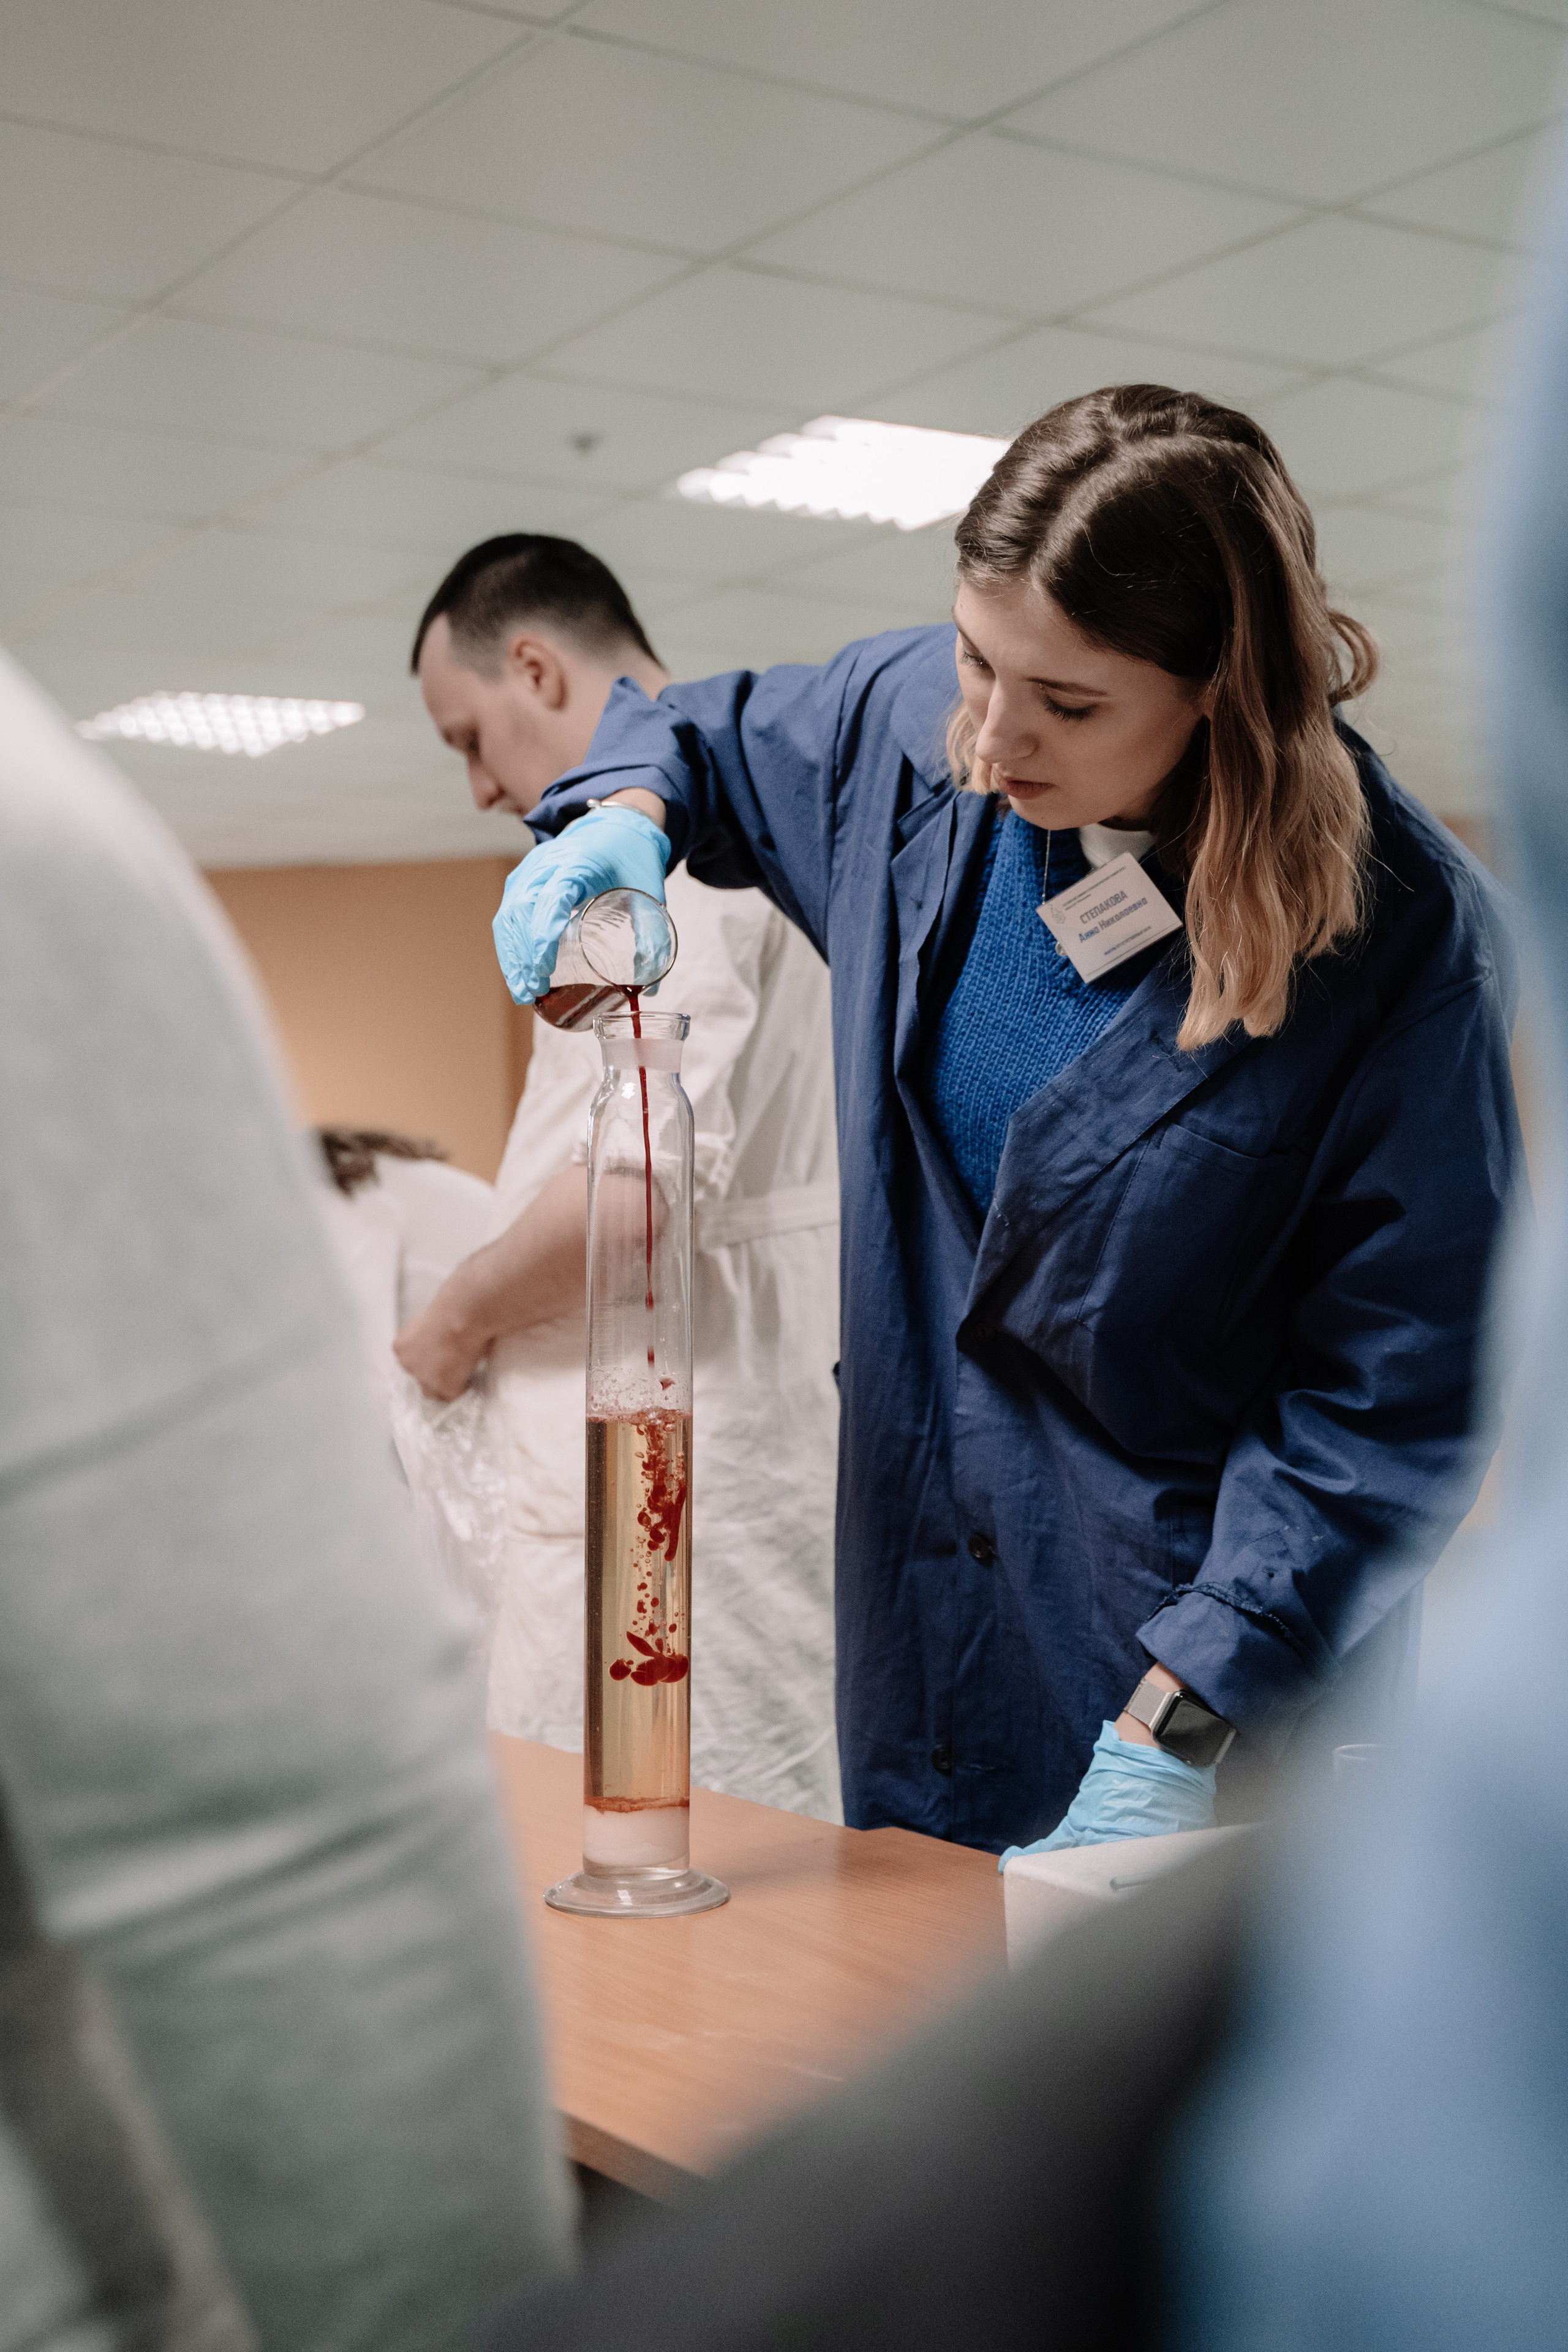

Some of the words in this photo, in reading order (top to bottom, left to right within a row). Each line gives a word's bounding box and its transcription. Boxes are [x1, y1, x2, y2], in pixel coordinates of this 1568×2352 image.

[1079, 927, 1099, 943] Анна
[1099, 897, 1148, 931] Николаевна
[1080, 890, 1128, 924] СТЕПАКОВА
